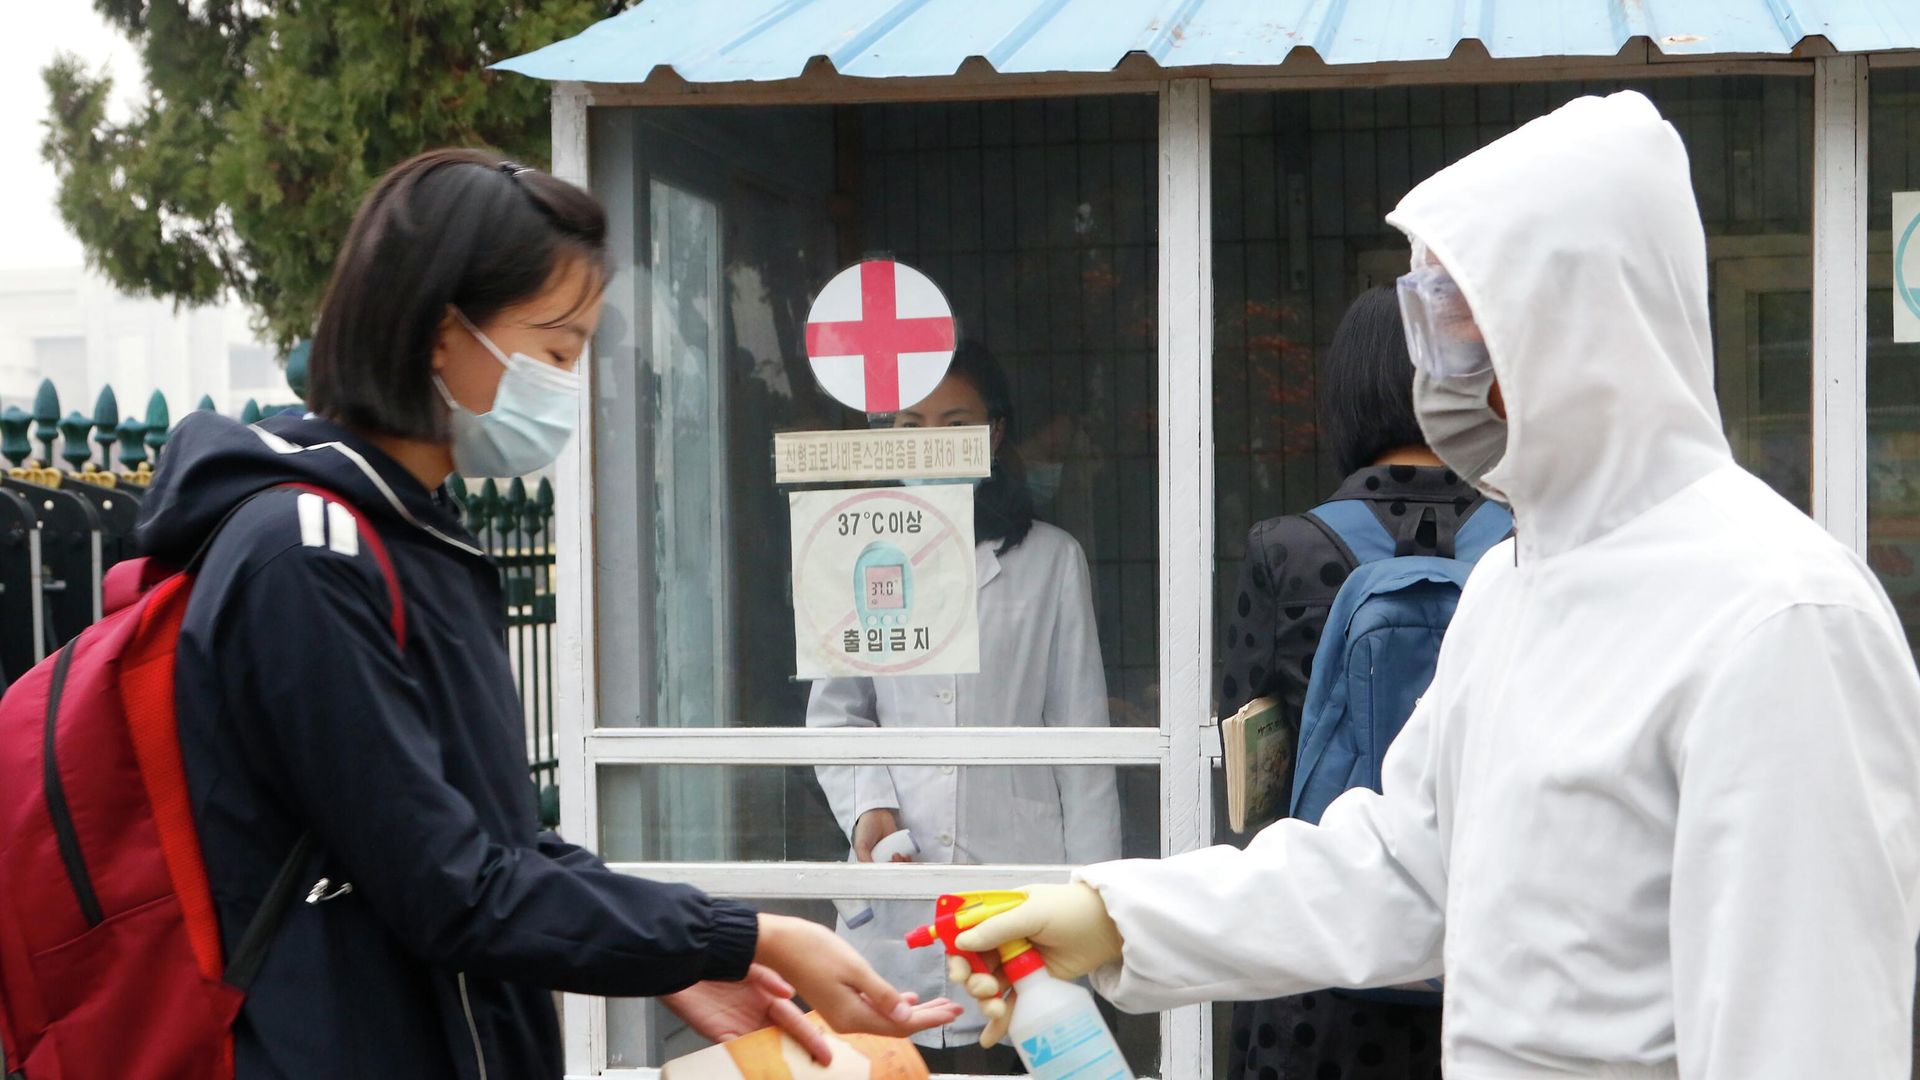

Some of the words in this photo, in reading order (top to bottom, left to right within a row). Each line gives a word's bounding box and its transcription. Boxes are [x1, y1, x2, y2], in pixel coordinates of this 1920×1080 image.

[786, 439, 916, 473] 신형코로나비루스감염증을
[923, 438, 956, 469] 철저히
[962, 436, 983, 467] 막자
[843, 627, 930, 653] 출입금지
